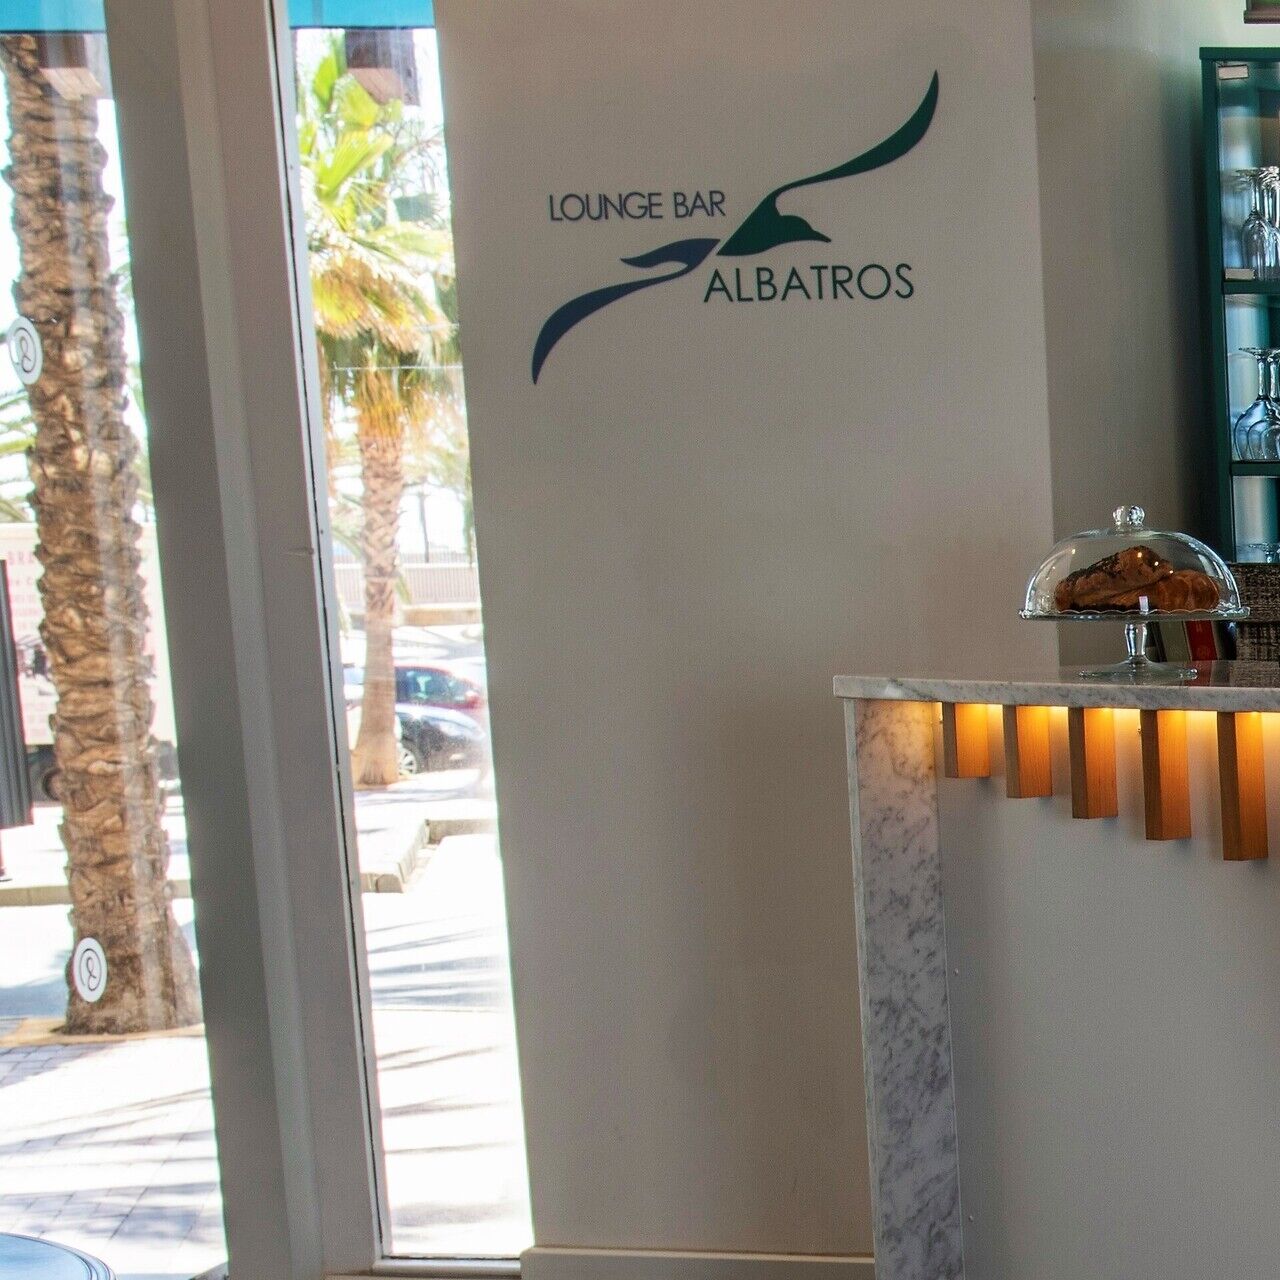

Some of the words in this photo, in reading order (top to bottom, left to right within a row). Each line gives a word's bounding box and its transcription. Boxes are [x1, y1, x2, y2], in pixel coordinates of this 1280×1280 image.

[549, 193, 662, 221] LOUNGE
[673, 190, 726, 218] BAR
[704, 263, 914, 302] ALBATROS
